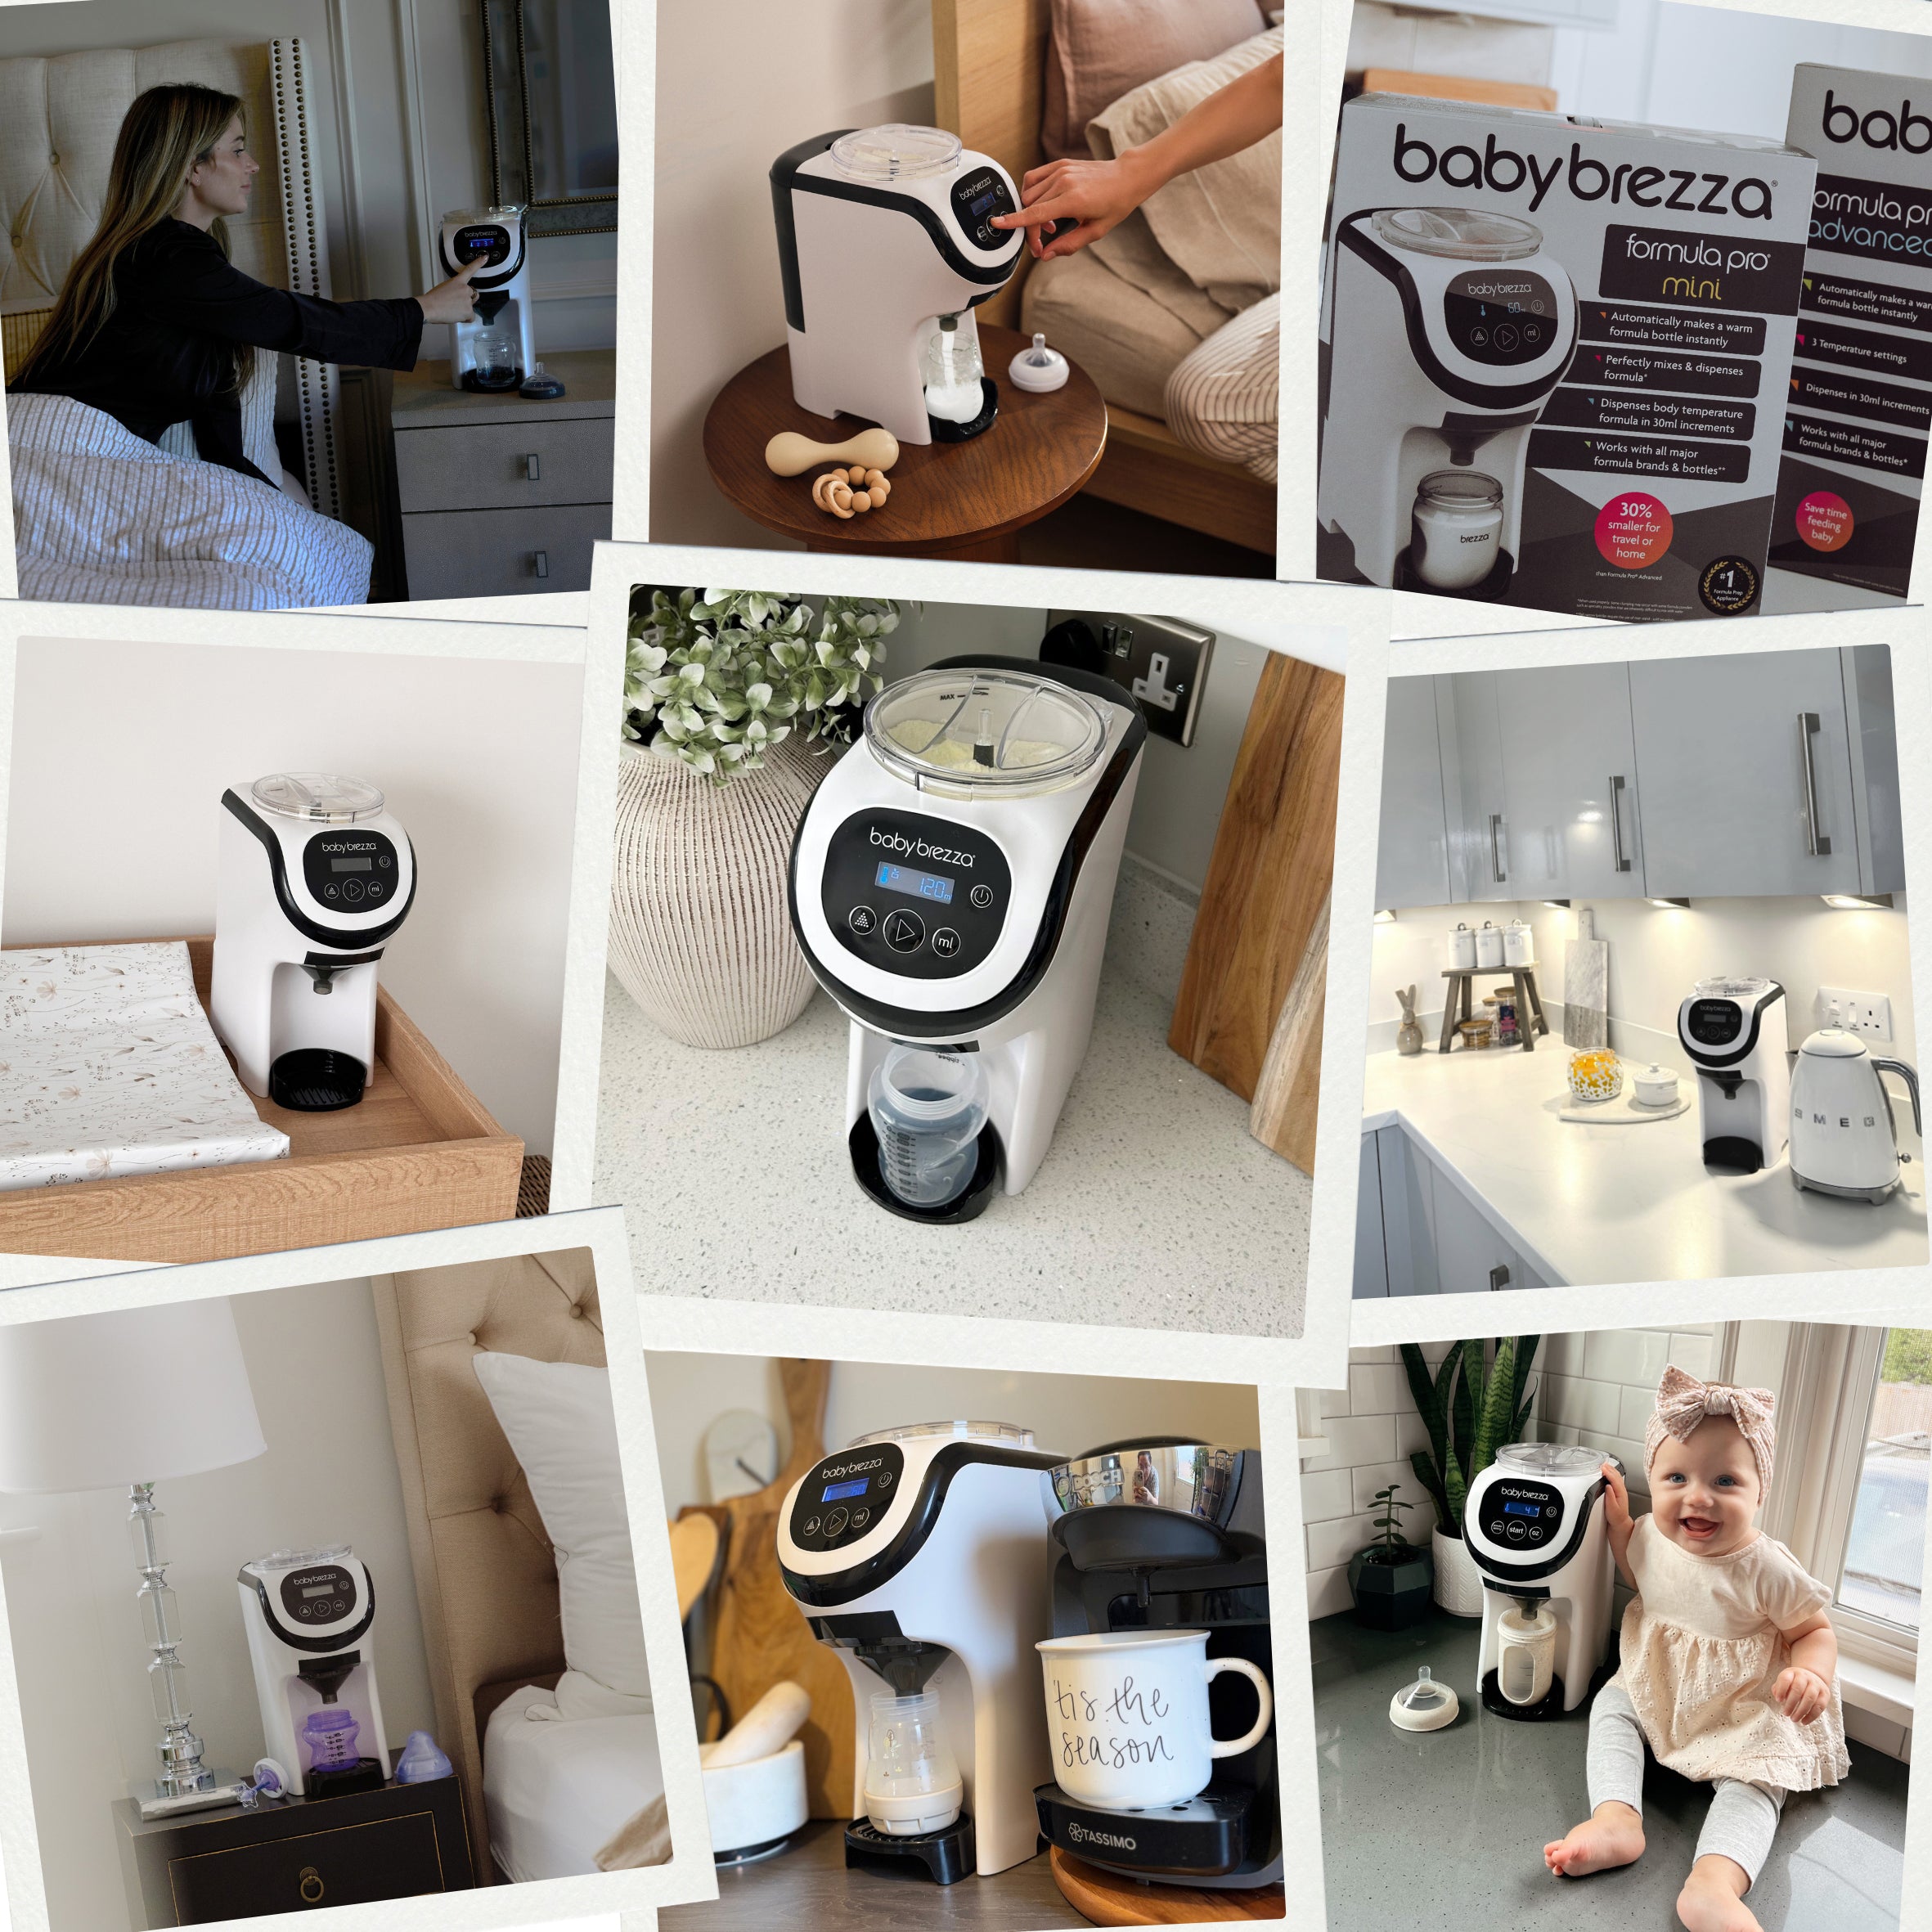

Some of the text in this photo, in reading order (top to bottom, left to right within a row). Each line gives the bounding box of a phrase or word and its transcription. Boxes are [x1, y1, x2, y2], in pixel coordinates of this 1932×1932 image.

[1813, 191, 1902, 221] ormula
[1626, 233, 1769, 274] formula pro
[1662, 276, 1722, 300] mini
[1819, 283, 1877, 301] Automatically
[1880, 294, 1907, 305] makes
[1817, 295, 1918, 322] formula bottle instantly
[1611, 312, 1753, 334] Automatically makes a warm
[1609, 326, 1728, 348] formula bottle instantly
[1812, 337, 1907, 365] 3 Temperature settings
[1606, 355, 1744, 376] Perfectly mixes & dispenses
[1601, 398, 1743, 419] Dispenses body temperature
[1806, 383, 1930, 415] Dispenses in 30ml increments
[1598, 413, 1735, 434] formula in 30ml increments
[1801, 424, 1887, 449] Works with all major
[1596, 441, 1698, 459] Works with all major
[1799, 437, 1831, 451] formula
[1833, 443, 1862, 457] brands
[1863, 451, 1871, 459] &
[1594, 456, 1633, 468] formula
[1636, 459, 1669, 471] brands
[1672, 462, 1679, 472] &
[1620, 502, 1652, 519] 30%
[1804, 502, 1848, 519] Save time
[1608, 520, 1661, 532] smaller for
[1808, 515, 1841, 533] feeding
[1460, 533, 1490, 544] brezza
[1612, 534, 1640, 545] travel
[1812, 528, 1834, 544] baby
[1616, 547, 1646, 559] home
[938, 937, 954, 949] ml
[855, 1512, 865, 1521] ml
[1509, 1526, 1524, 1534] start
[1054, 1675, 1169, 1726] 'tis the
[1063, 1732, 1174, 1769] season
[1081, 1828, 1136, 1850] TASSIMO
